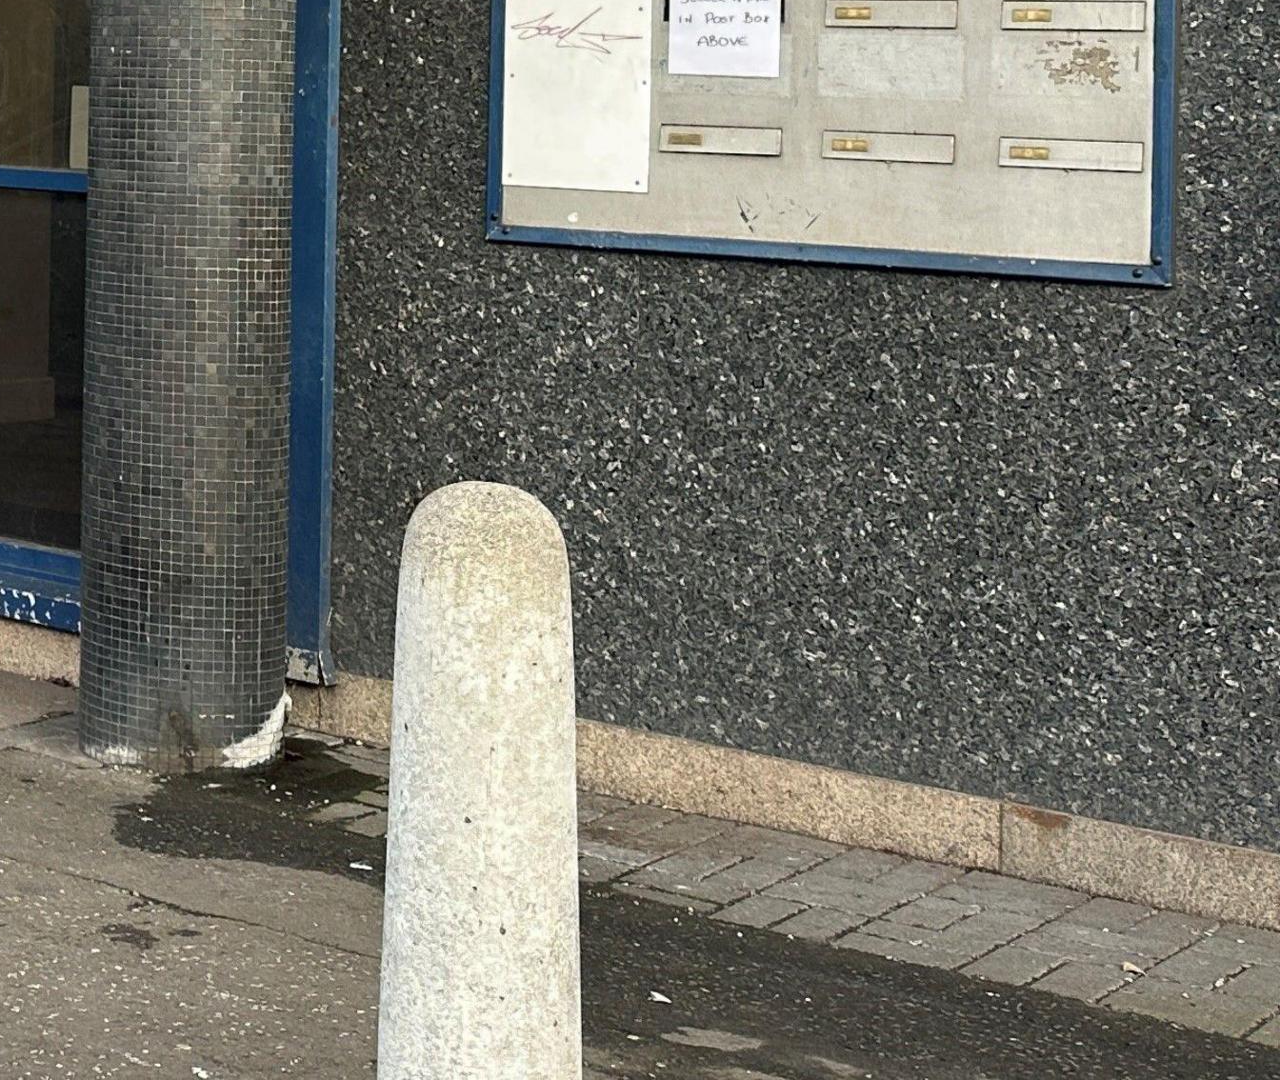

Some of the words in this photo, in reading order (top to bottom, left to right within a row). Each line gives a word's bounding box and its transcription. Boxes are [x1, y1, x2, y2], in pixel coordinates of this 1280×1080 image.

[704, 11, 736, 25] POST
[743, 11, 771, 25] BOX
[697, 34, 750, 47] ABOVE
